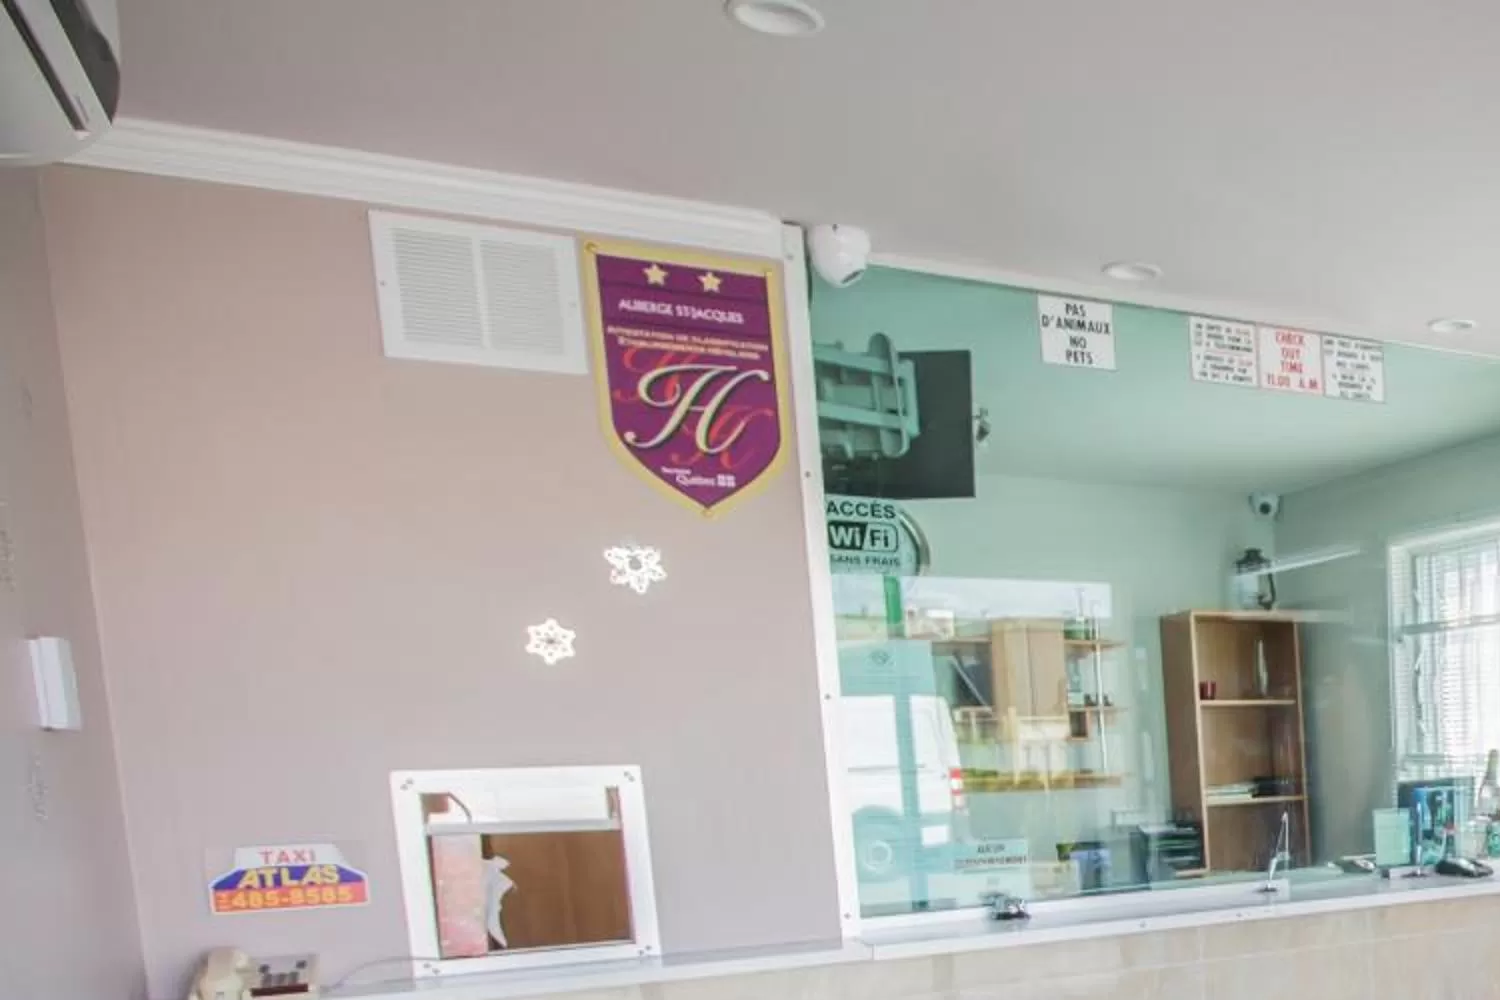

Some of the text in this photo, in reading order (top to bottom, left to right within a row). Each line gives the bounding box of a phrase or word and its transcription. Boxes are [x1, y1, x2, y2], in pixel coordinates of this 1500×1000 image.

[1065, 303, 1086, 317] PAS
[1041, 314, 1110, 335] D'ANIMAUX
[1069, 335, 1087, 349] NO
[1065, 349, 1094, 365] PETS
[260, 849, 317, 866] TAXI
[236, 864, 340, 890] ATLAS
